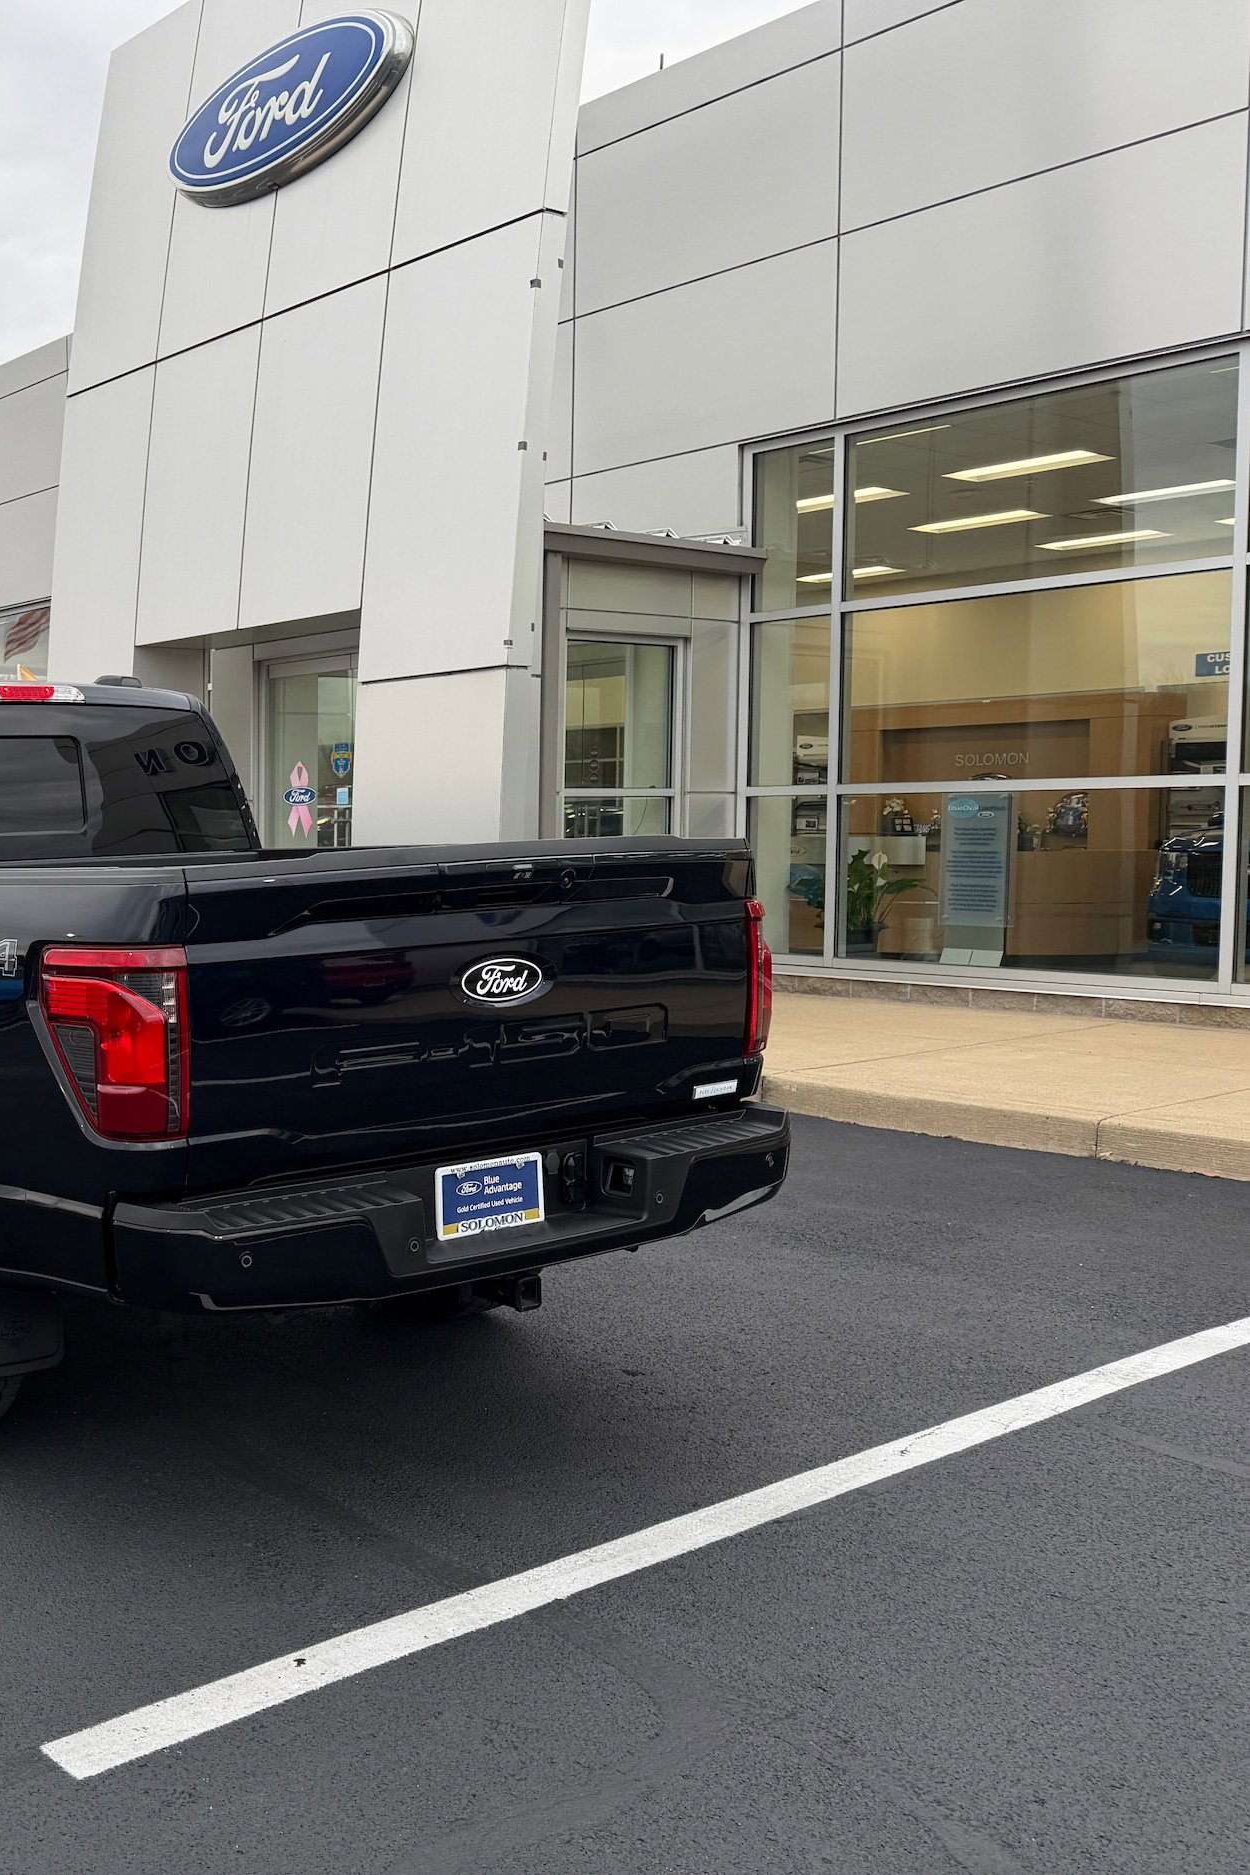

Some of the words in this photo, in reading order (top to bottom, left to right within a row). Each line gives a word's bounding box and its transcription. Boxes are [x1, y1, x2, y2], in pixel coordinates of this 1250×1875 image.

[203, 51, 331, 169] Ford
[954, 751, 1029, 767] SOLOMON
[289, 788, 311, 802] Ford
[476, 965, 528, 995] Ford
[483, 1175, 500, 1185] Blue
[483, 1181, 523, 1195] Advantage
[461, 1184, 478, 1194] Ford
[456, 1205, 469, 1213] Gold
[470, 1201, 490, 1211] Certified
[491, 1199, 505, 1207] Used
[505, 1196, 524, 1205] Vehicle
[460, 1212, 524, 1233] SOLOMON
